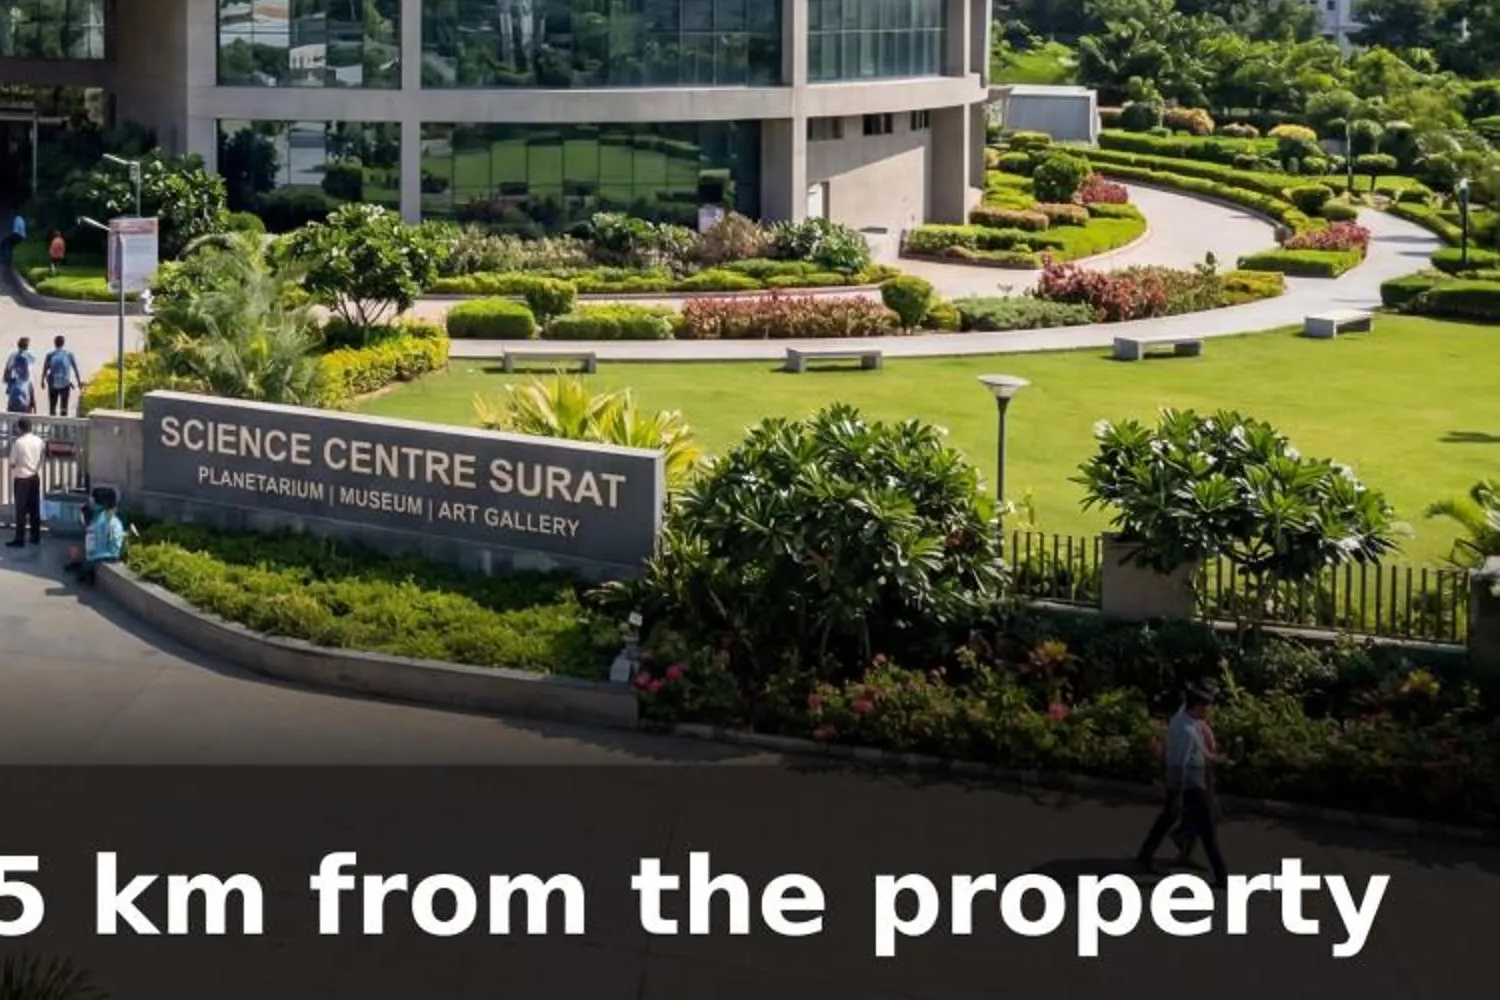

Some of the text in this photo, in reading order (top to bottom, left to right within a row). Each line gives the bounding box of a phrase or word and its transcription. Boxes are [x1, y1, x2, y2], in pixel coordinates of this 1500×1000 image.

[160, 416, 627, 509] SCIENCE CENTRE SURAT
[198, 466, 324, 501] PLANETARIUM
[340, 486, 423, 516] MUSEUM
[438, 501, 478, 524] ART
[483, 507, 580, 539] GALLERY
